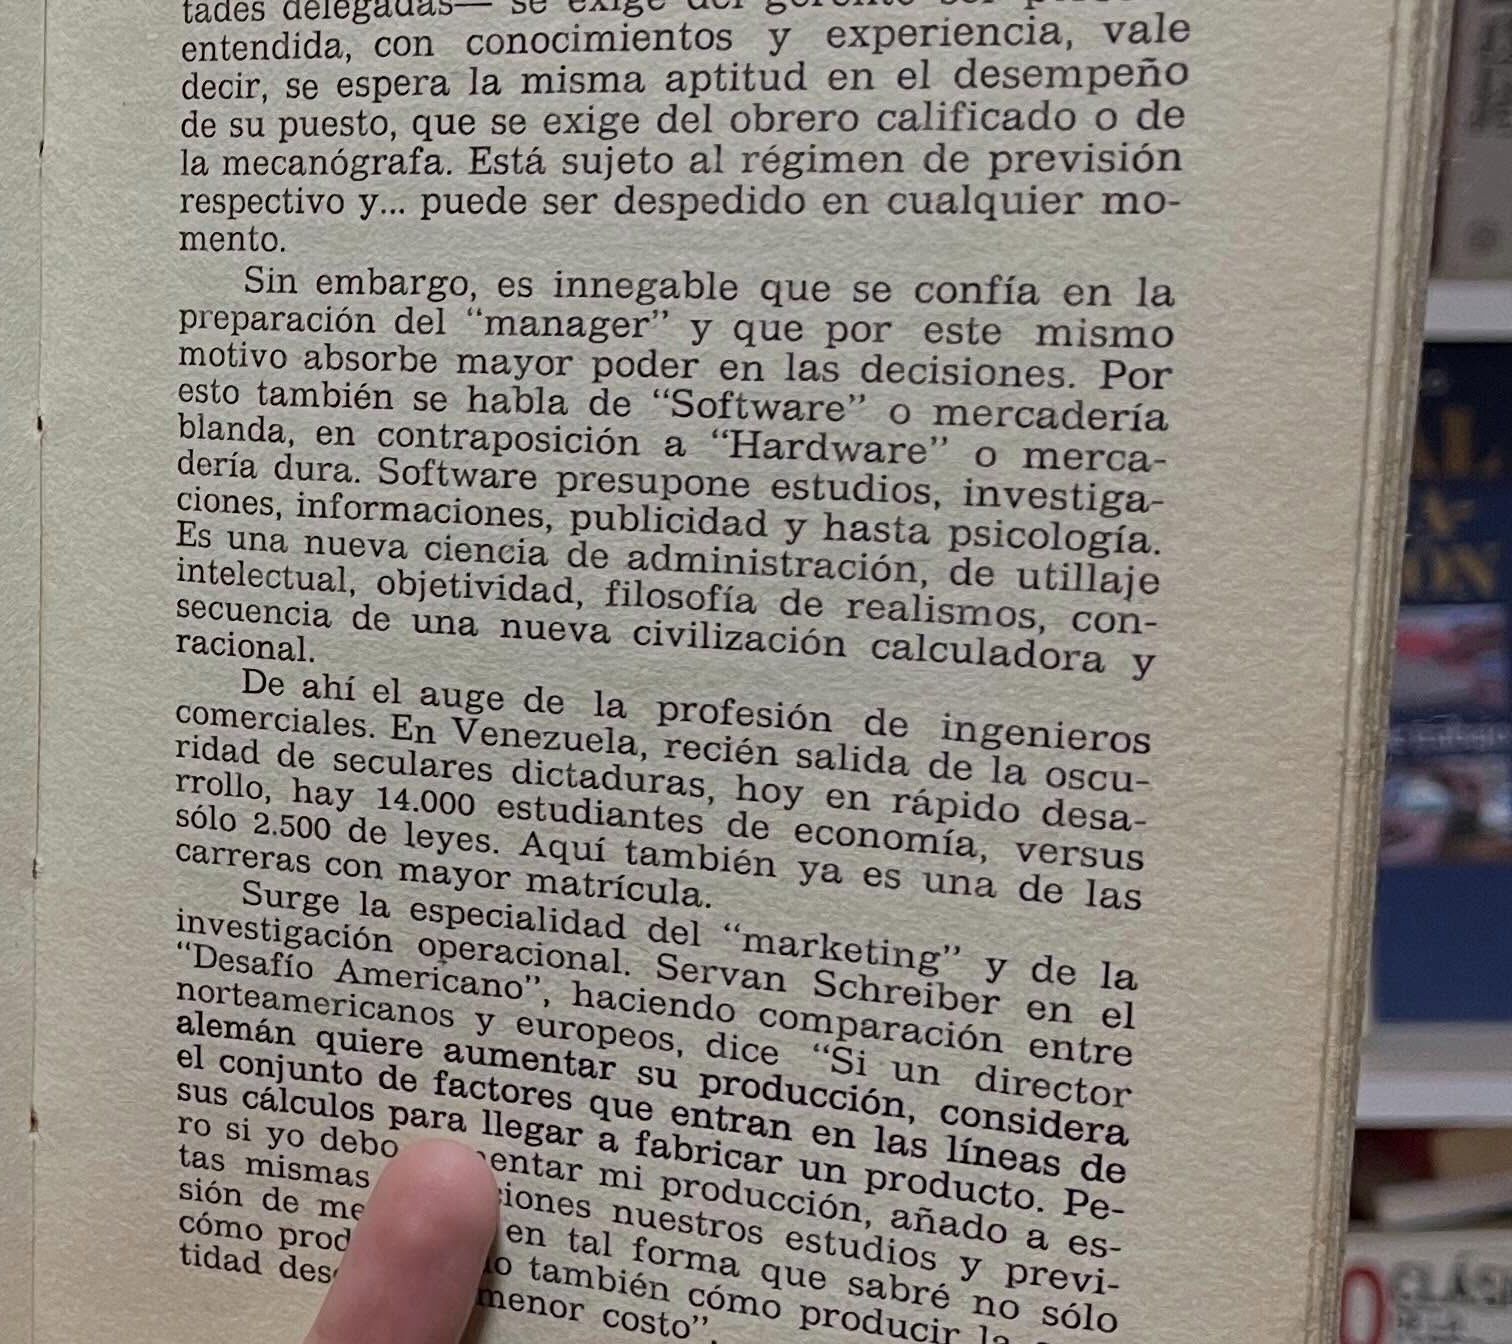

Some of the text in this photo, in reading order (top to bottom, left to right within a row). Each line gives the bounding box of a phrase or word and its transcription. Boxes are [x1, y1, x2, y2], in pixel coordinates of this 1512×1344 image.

[181, 11, 1191, 65] entendida, con conocimientos y experiencia, vale
[178, 225, 286, 253] mento.
[178, 305, 377, 337] preparación
[394, 305, 447, 336] del
[689, 319, 714, 347] y
[733, 319, 804, 348] que
[824, 320, 893, 350] por
[923, 316, 1002, 346] este
[1034, 317, 1175, 349] mismo
[176, 411, 295, 449] blanda,
[315, 425, 356, 447] en
[377, 423, 641, 458] contraposición
[664, 435, 687, 458] a
[974, 446, 997, 468] o
[1021, 447, 1167, 473] merca-
[175, 630, 316, 663] racional.
[175, 770, 1145, 872] rrollo, hay 14.000 estudiantes de economía, versus
[242, 879, 340, 918] Surge
[358, 890, 391, 919] la
[409, 902, 628, 940] especialidad
[647, 915, 702, 948] del
[984, 957, 1009, 985] y
[1031, 954, 1077, 987] de
[1099, 960, 1139, 992] la
[177, 1115, 212, 1137] ro
[226, 1116, 252, 1142] si
[265, 1126, 305, 1151] yo
[319, 1122, 399, 1159] debo
[598, 1164, 644, 1192] mi
[658, 1160, 877, 1234] producción,
[889, 1197, 1012, 1245] añado
[1026, 1228, 1050, 1251] a
[1068, 1234, 1122, 1259] es-
